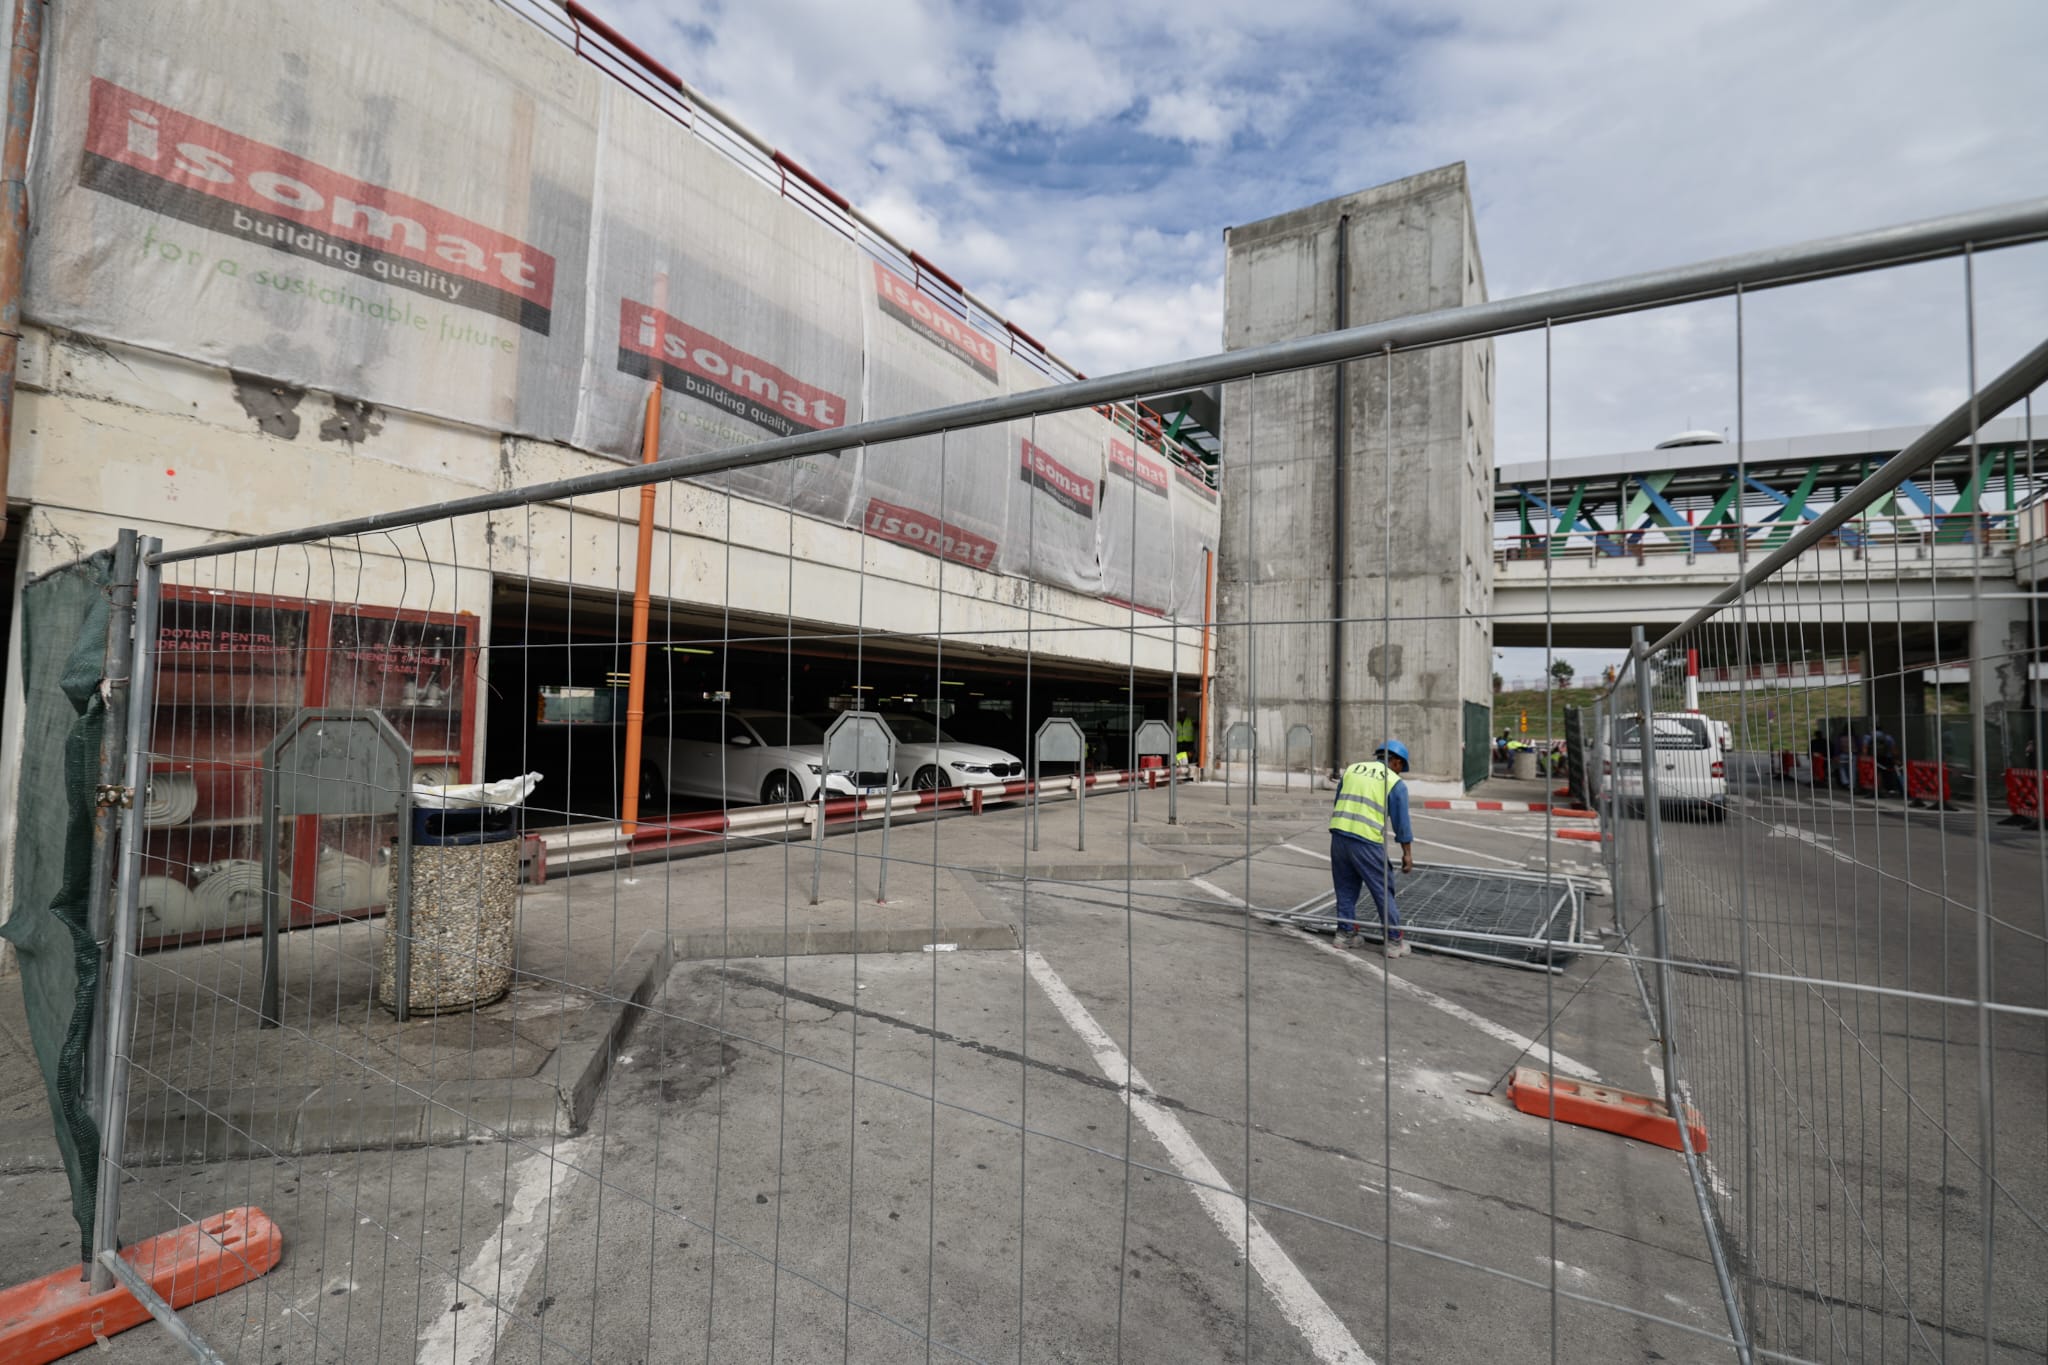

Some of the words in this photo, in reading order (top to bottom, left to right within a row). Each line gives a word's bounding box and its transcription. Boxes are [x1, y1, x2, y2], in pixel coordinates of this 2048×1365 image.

[127, 107, 536, 289] isomat
[232, 209, 362, 269] building
[372, 258, 464, 300] quality
[143, 222, 202, 266] for
[217, 258, 239, 277] a
[255, 268, 428, 332] sustainable
[439, 313, 515, 355] future
[882, 271, 992, 363] isomat
[638, 314, 836, 426] isomat
[685, 375, 746, 416] building
[750, 406, 794, 436] quality
[1028, 446, 1092, 501] isomat
[1112, 443, 1167, 485] isomat
[870, 507, 989, 563] isomat
[220, 631, 275, 643] PENTRU
[1352, 764, 1388, 781] DAS
